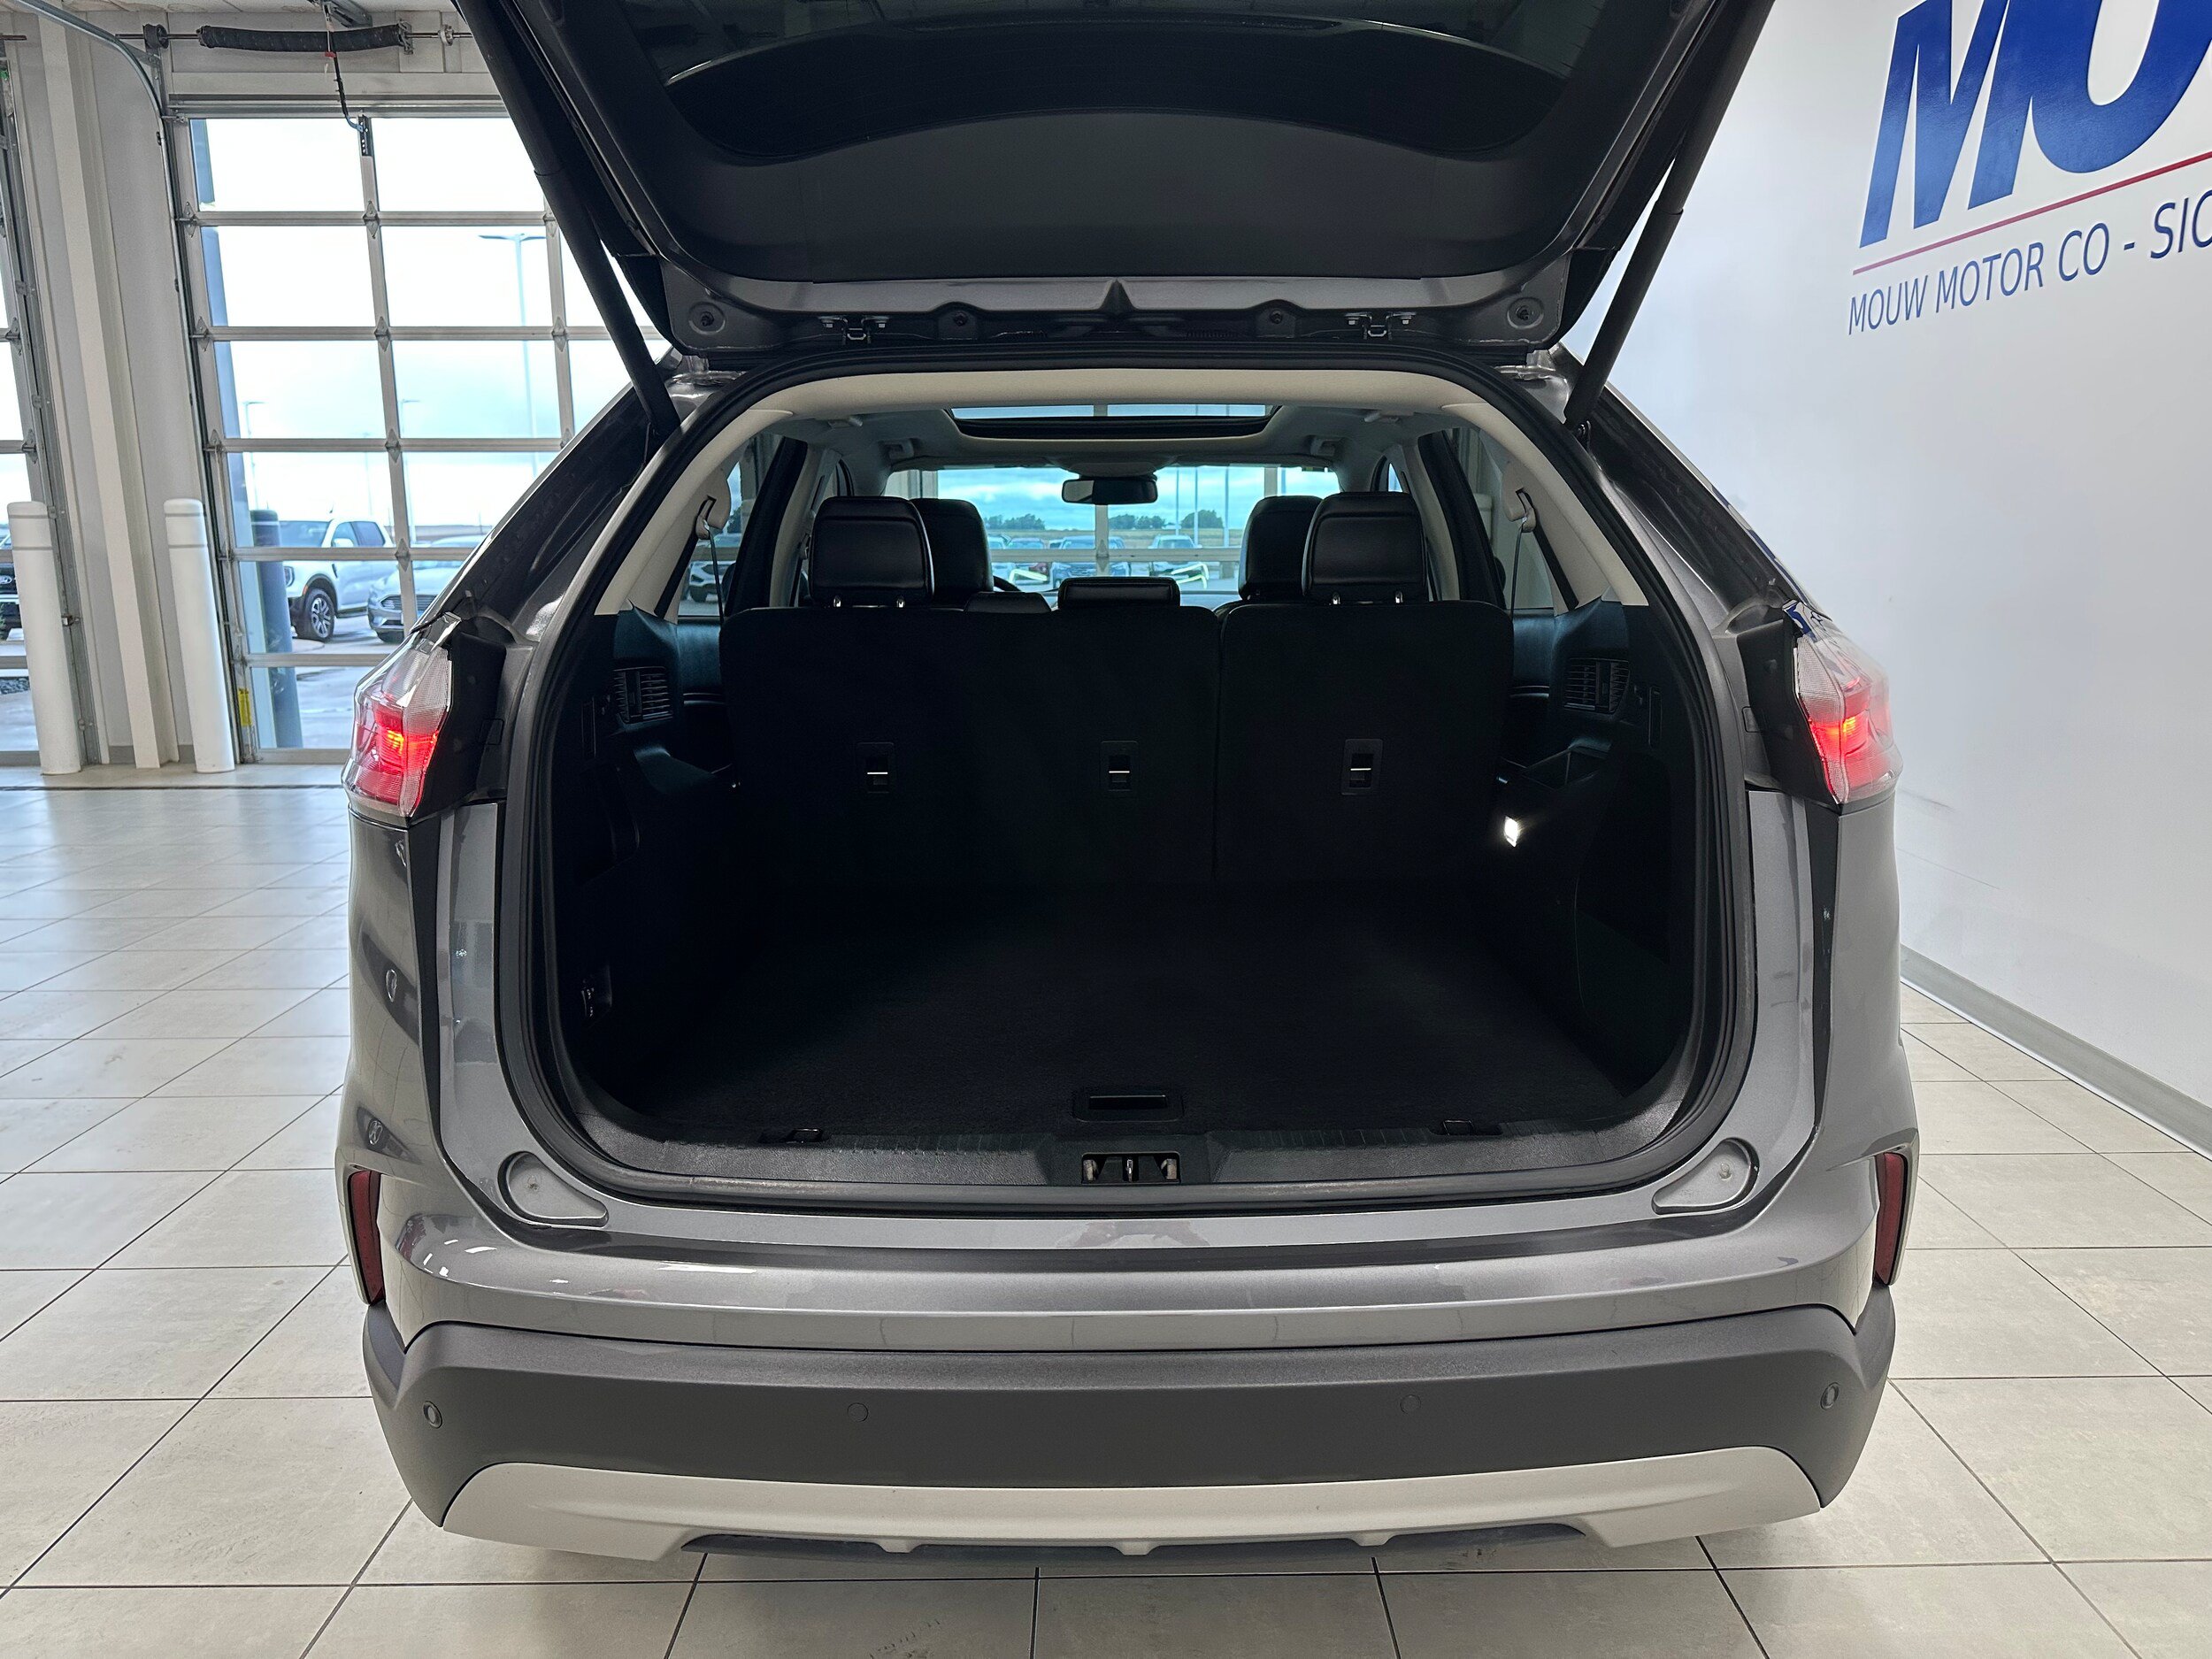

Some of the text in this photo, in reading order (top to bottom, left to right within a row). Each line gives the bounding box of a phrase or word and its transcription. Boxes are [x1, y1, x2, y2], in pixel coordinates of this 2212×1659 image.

[1848, 275, 1929, 335] MOUW
[1935, 242, 2044, 313] MOTOR
[2058, 222, 2110, 282] CO
